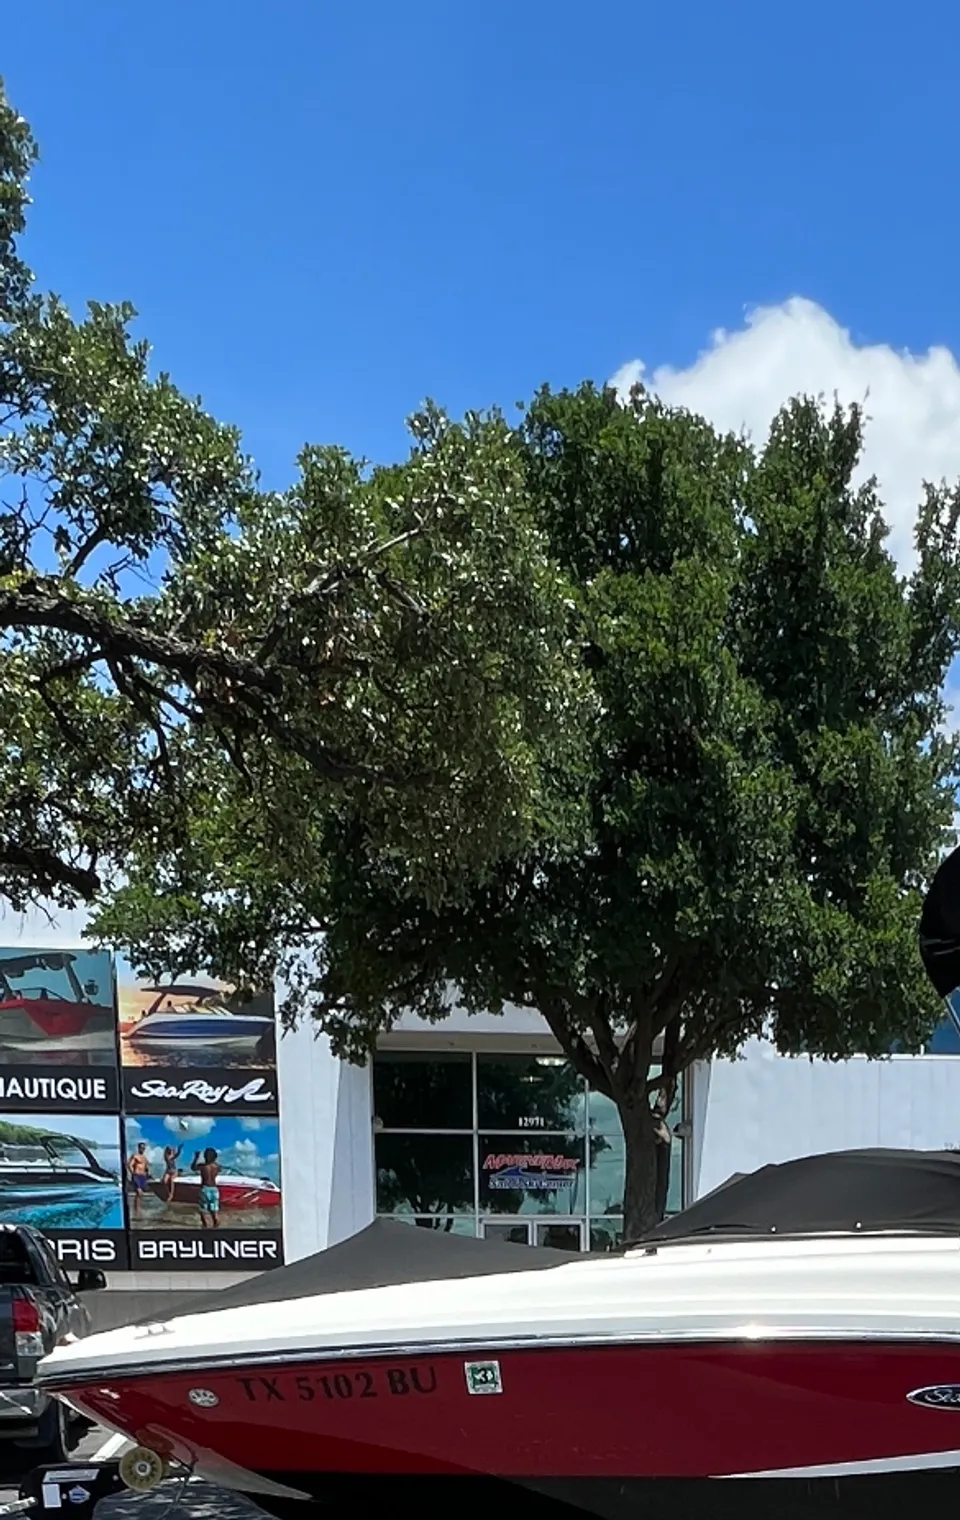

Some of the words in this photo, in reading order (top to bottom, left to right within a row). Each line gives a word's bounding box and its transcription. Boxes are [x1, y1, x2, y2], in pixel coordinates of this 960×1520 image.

[0, 1077, 106, 1100] AUTIQUE
[48, 1239, 116, 1261] RIS
[138, 1240, 278, 1259] BAYLINER
[236, 1376, 285, 1401] TX
[296, 1372, 378, 1400] 5102
[387, 1366, 438, 1396] BU
